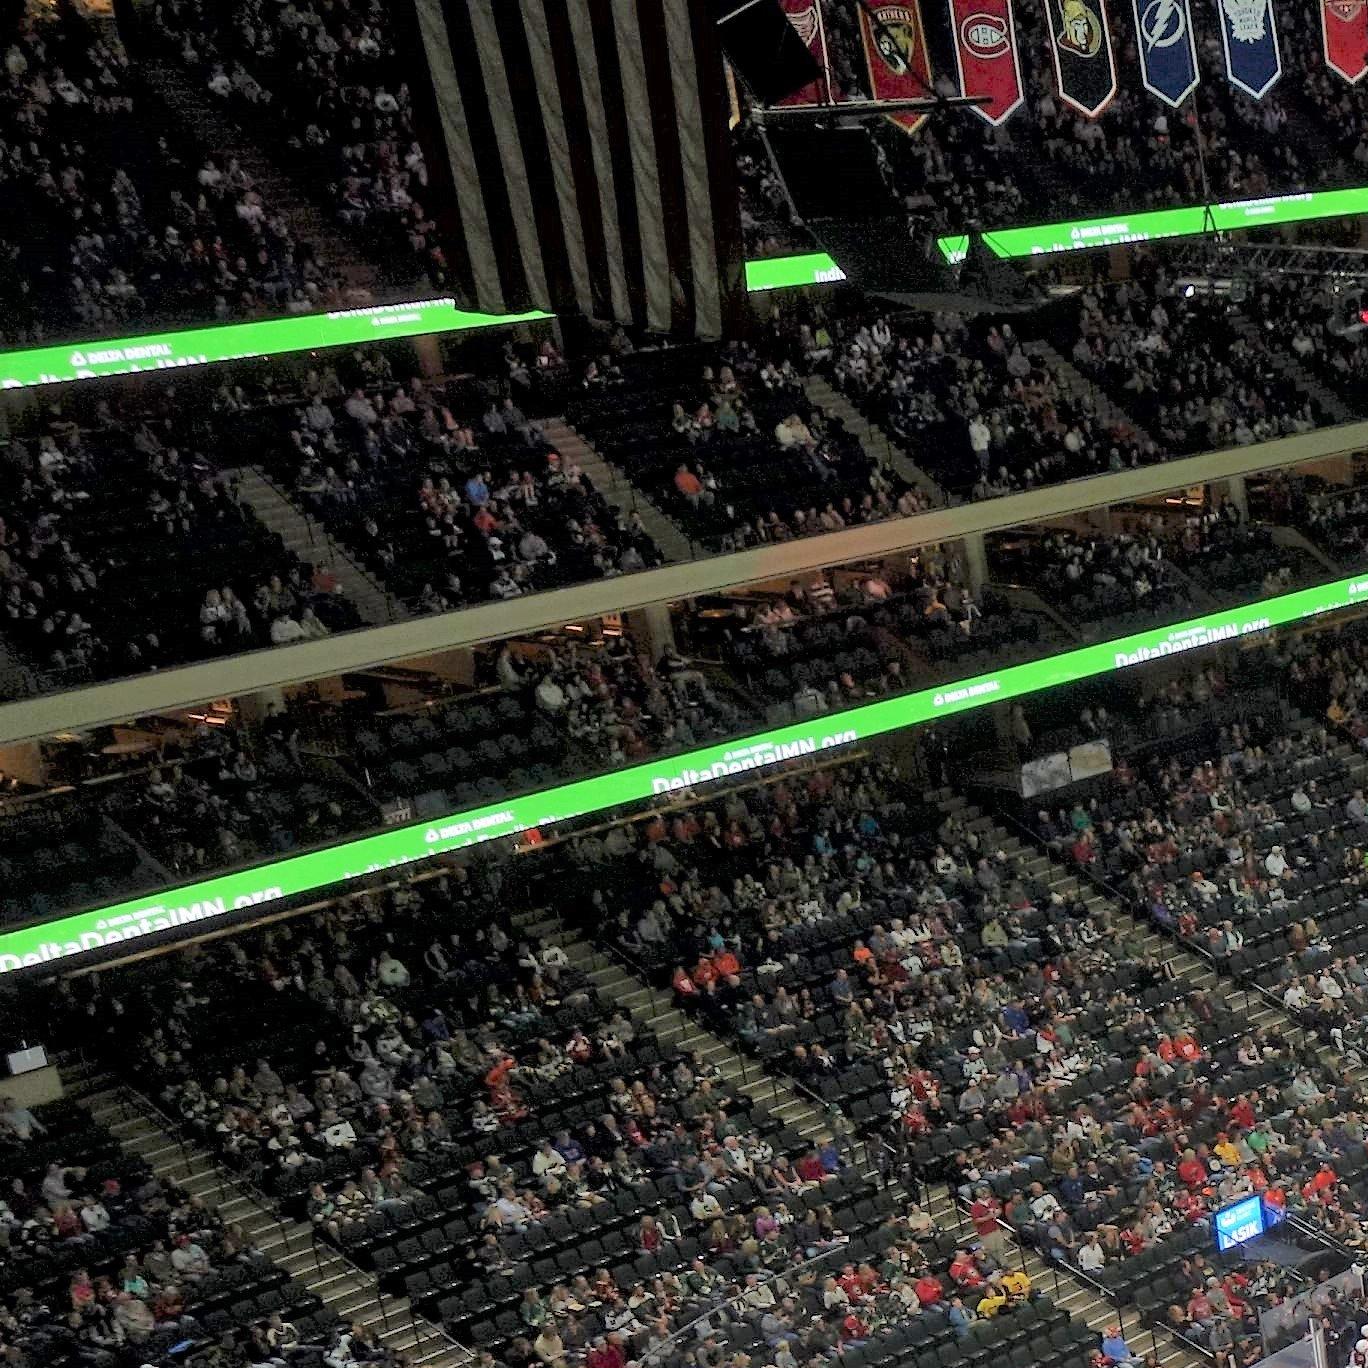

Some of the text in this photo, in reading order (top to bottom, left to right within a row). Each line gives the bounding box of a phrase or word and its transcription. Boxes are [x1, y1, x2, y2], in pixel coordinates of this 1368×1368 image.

[1114, 617, 1270, 668] DeltaDentalMNorg
[652, 729, 857, 794] DeltaDentalMNorg
[0, 886, 284, 973] DeltaDentalMNorg
